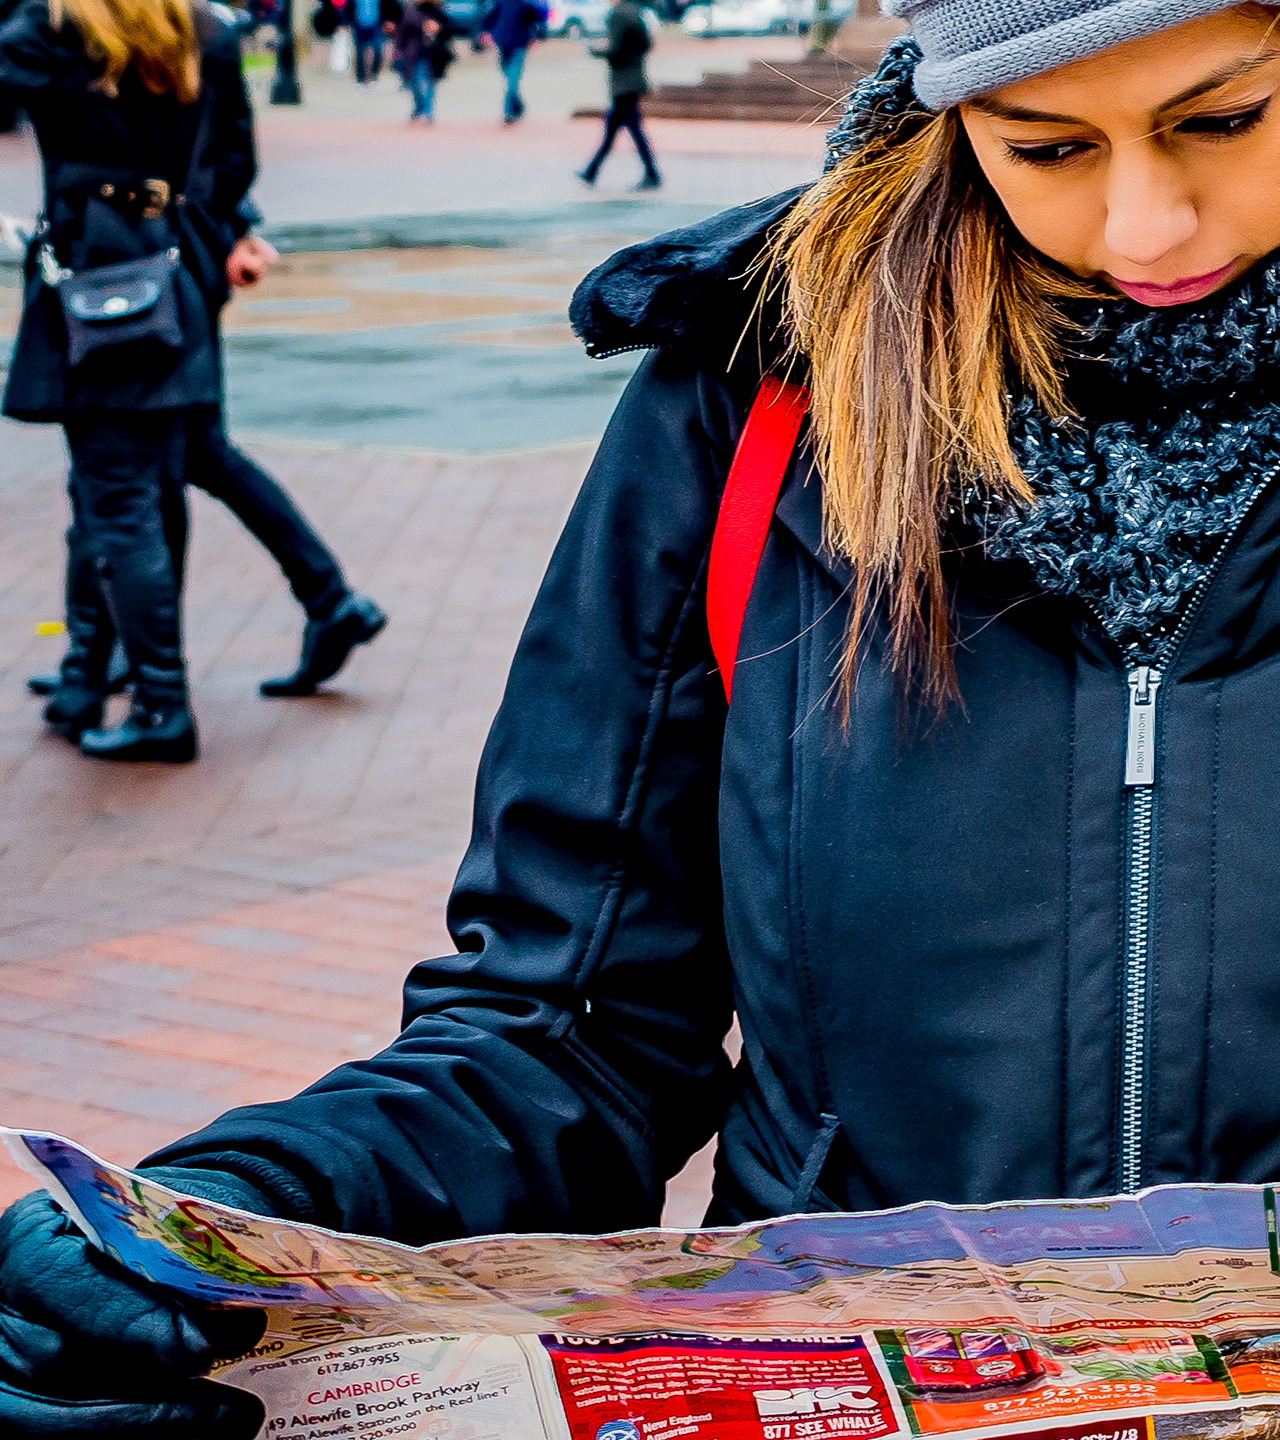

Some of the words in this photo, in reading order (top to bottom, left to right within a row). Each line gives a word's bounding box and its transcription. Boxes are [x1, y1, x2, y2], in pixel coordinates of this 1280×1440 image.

[1137, 712, 1146, 750] MICHAEL
[1136, 751, 1145, 774] KORS
[291, 1355, 320, 1365] from
[324, 1351, 344, 1359] the
[349, 1340, 403, 1355] Sheraton
[317, 1353, 400, 1375] 617.867.9955
[307, 1373, 421, 1405] CAMBRIDGE
[984, 1384, 1157, 1411] 877-521-3552
[291, 1407, 351, 1428] Alewife
[356, 1397, 408, 1416] Brook
[412, 1381, 480, 1402] Parkway
[309, 1425, 354, 1439] Alewife
[358, 1416, 400, 1430] Station
[406, 1410, 421, 1418] on
[425, 1404, 445, 1412] the
[449, 1396, 473, 1407] Red
[477, 1391, 498, 1400] line
[501, 1386, 509, 1394] T
[801, 1411, 840, 1420] HARBOR
[642, 1420, 667, 1433] New
[669, 1413, 712, 1425] England
[646, 1425, 699, 1440] Aquarium
[762, 1424, 790, 1439] 877
[794, 1420, 826, 1436] SEE
[827, 1414, 882, 1430] WHALE
